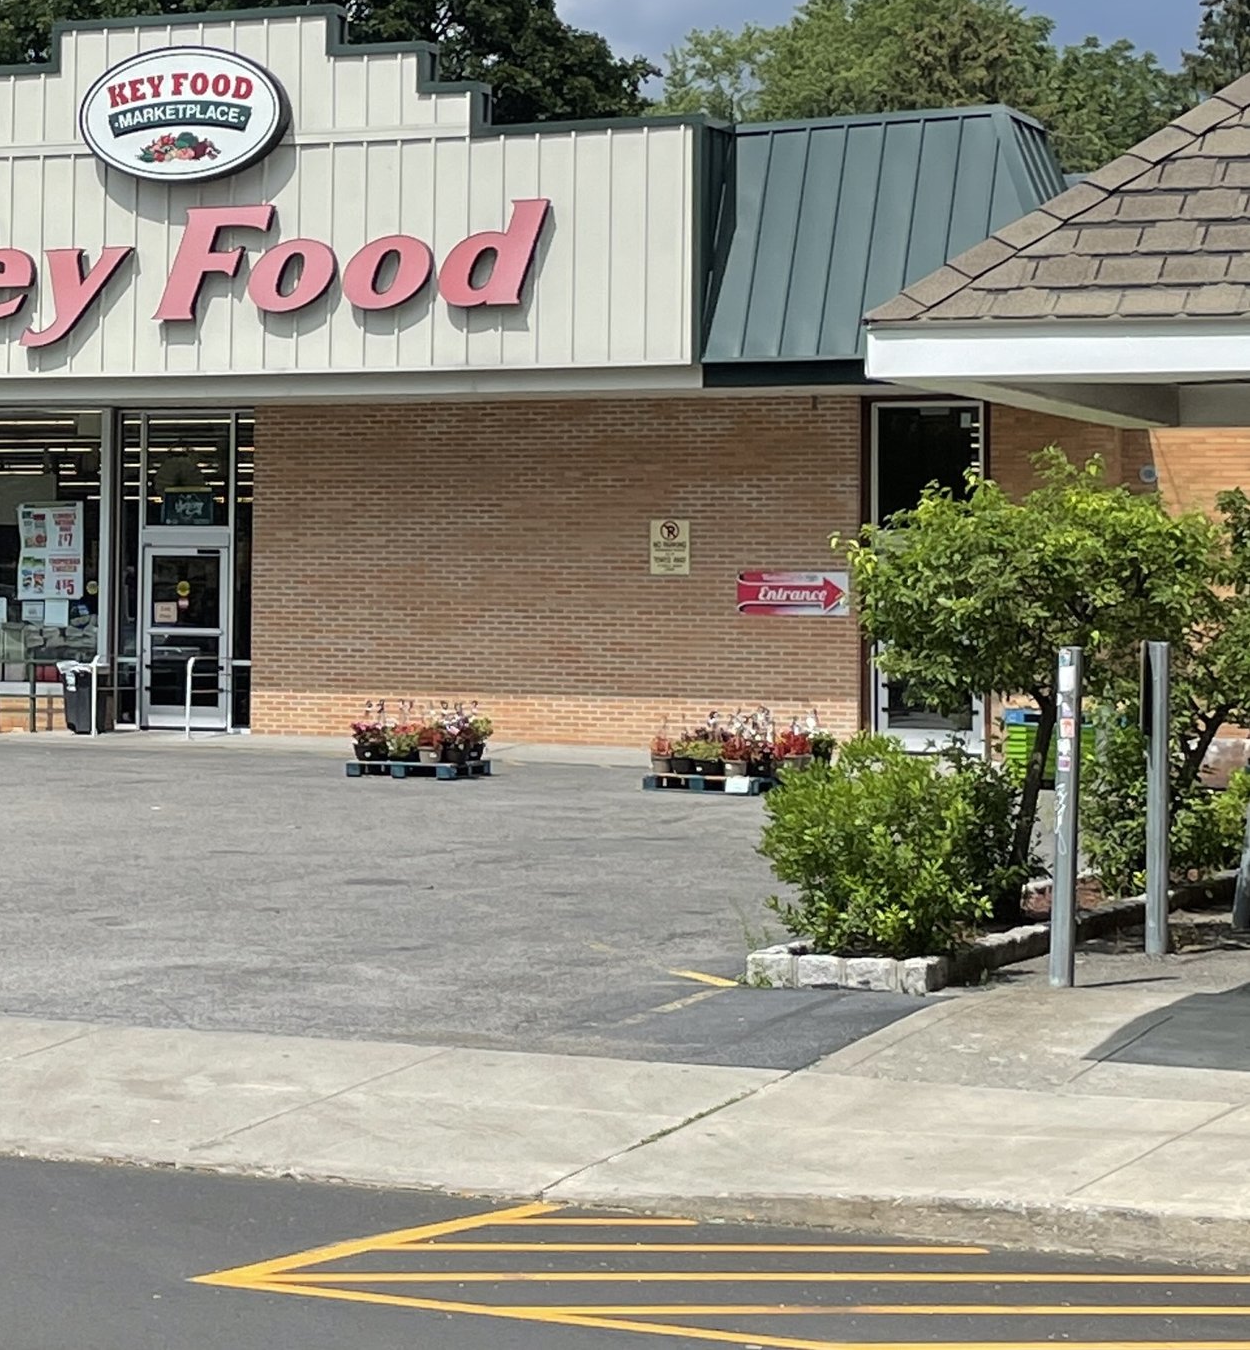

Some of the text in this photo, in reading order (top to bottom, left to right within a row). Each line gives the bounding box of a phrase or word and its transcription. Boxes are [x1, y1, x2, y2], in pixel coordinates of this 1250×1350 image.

[107, 72, 254, 109] KEY FOOD
[118, 104, 240, 128] MARKETPLACE
[152, 198, 553, 321] Food
[758, 586, 827, 601] Entrance
